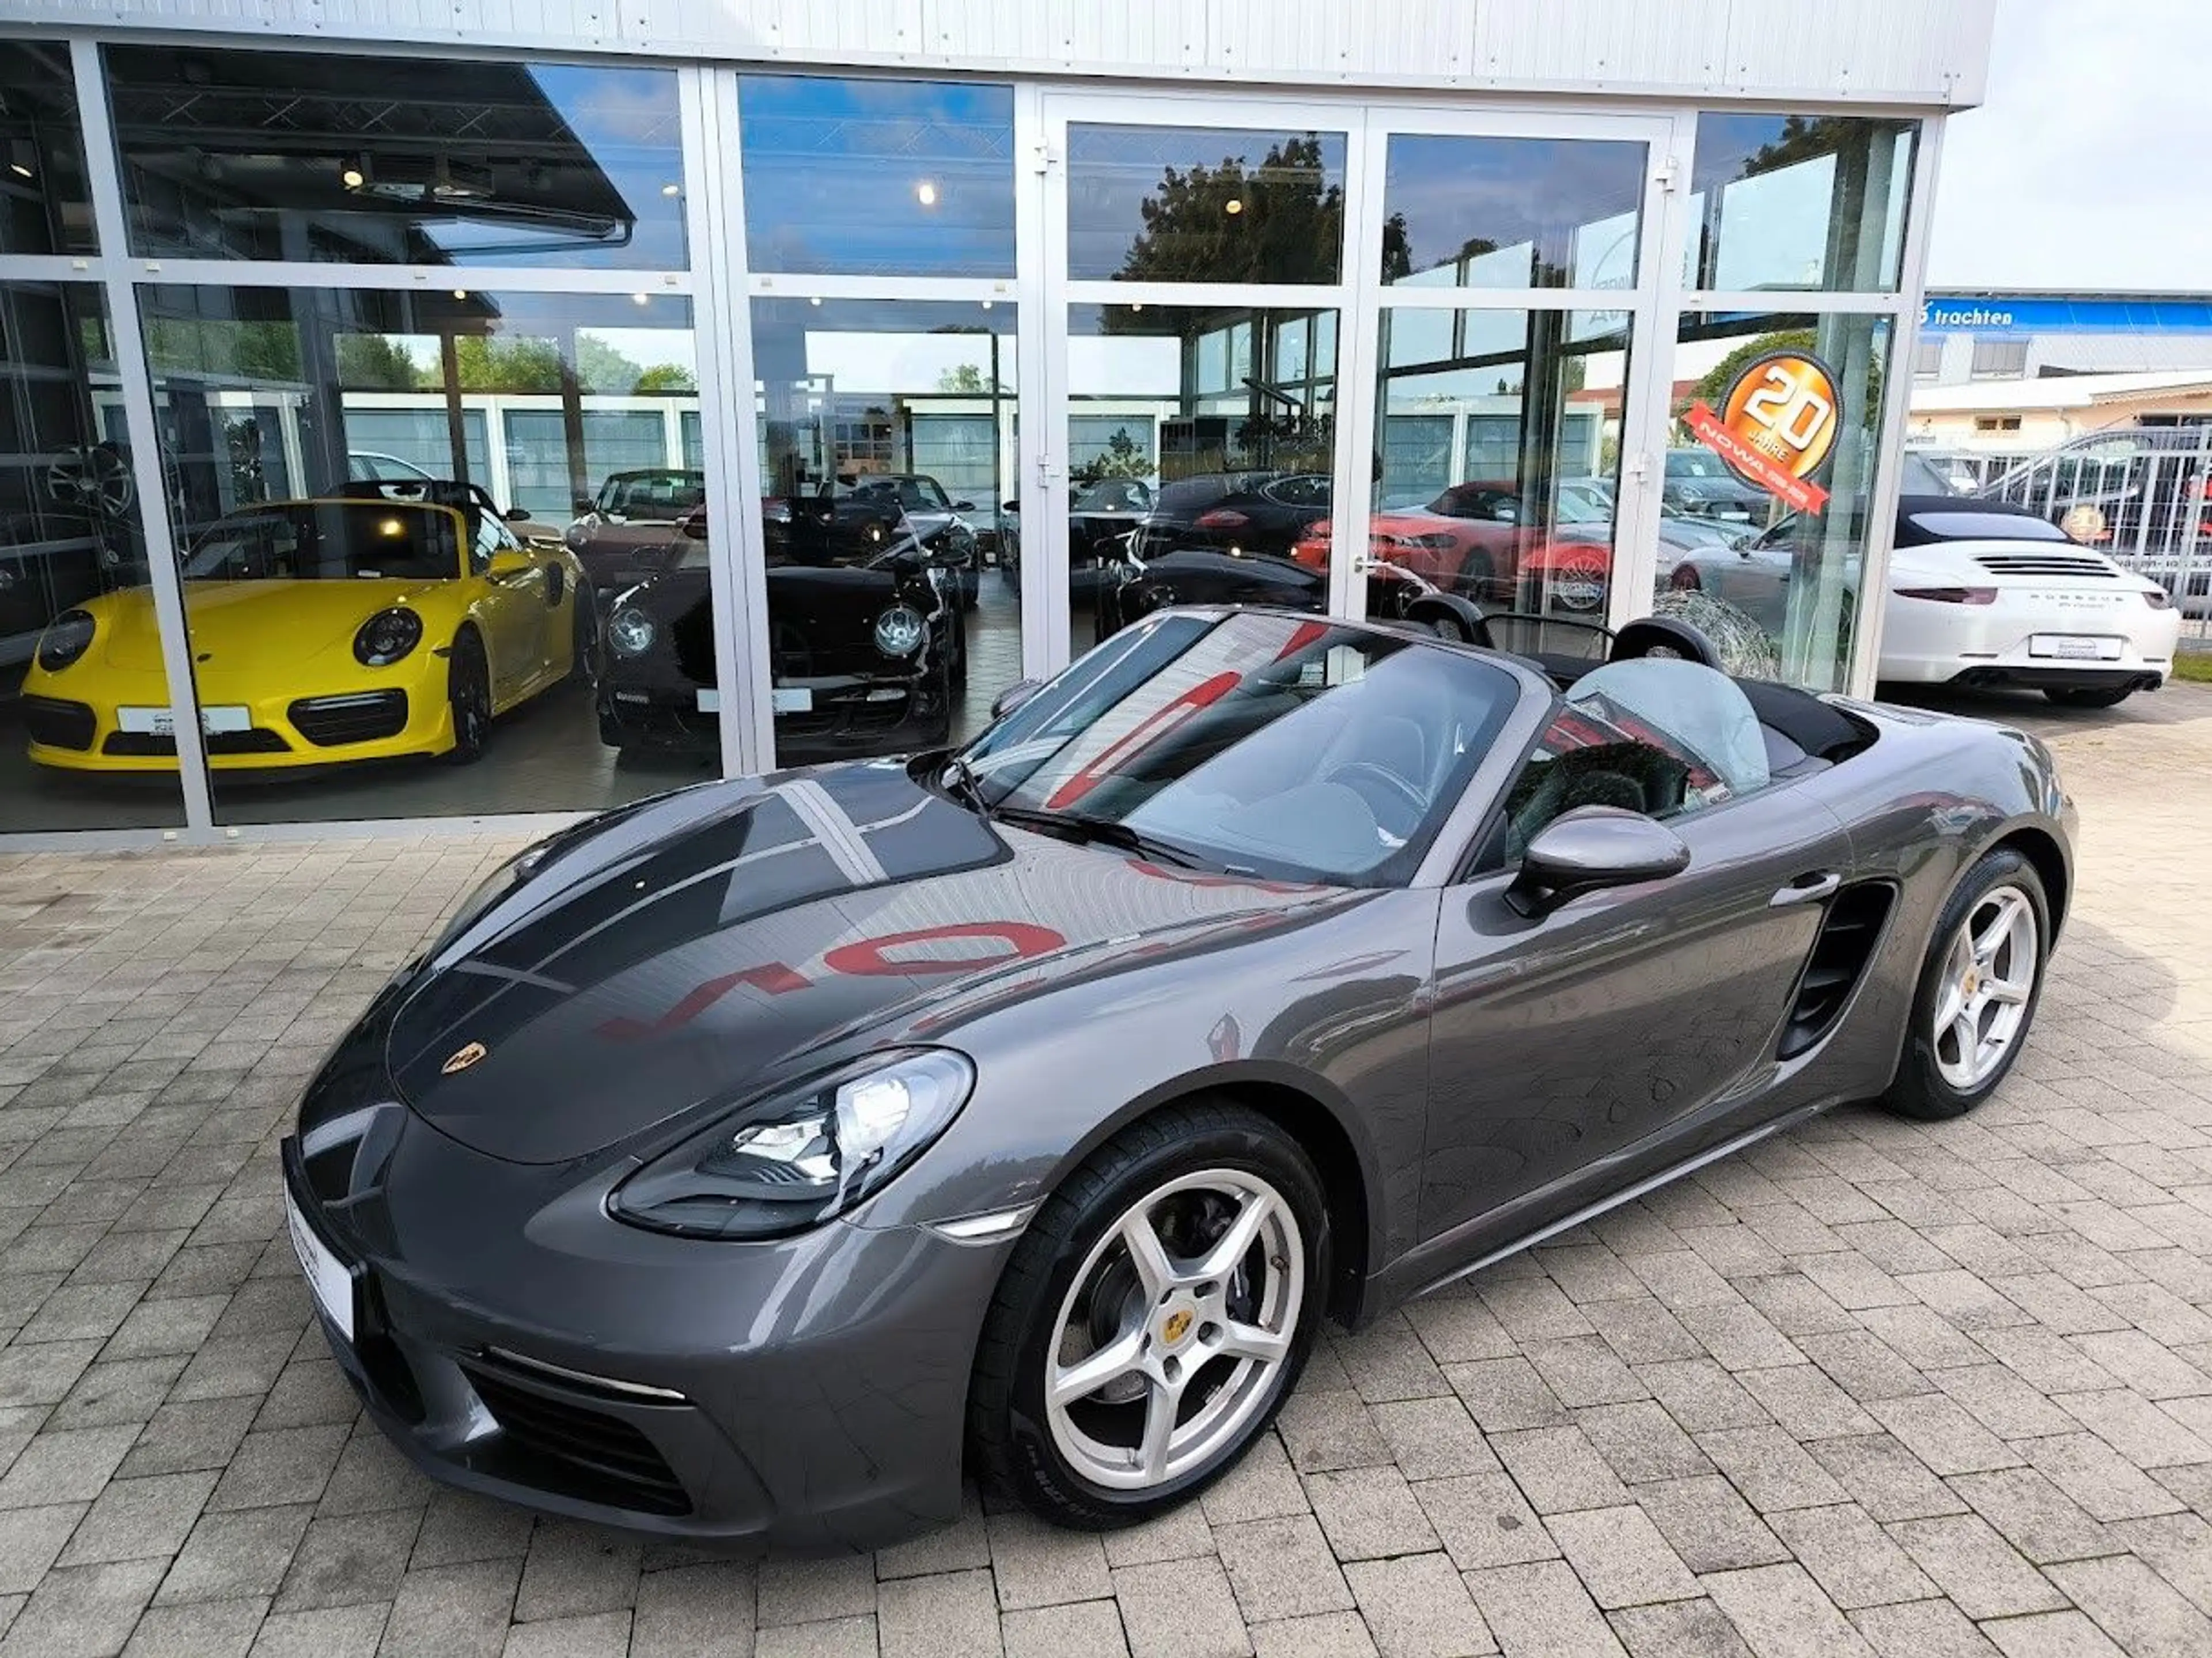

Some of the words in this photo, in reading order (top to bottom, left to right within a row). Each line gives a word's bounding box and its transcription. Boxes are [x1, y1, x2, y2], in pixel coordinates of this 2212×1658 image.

[1934, 308, 2013, 325] trachten
[1743, 365, 1831, 451] 20
[1699, 422, 1764, 474] NOWA
